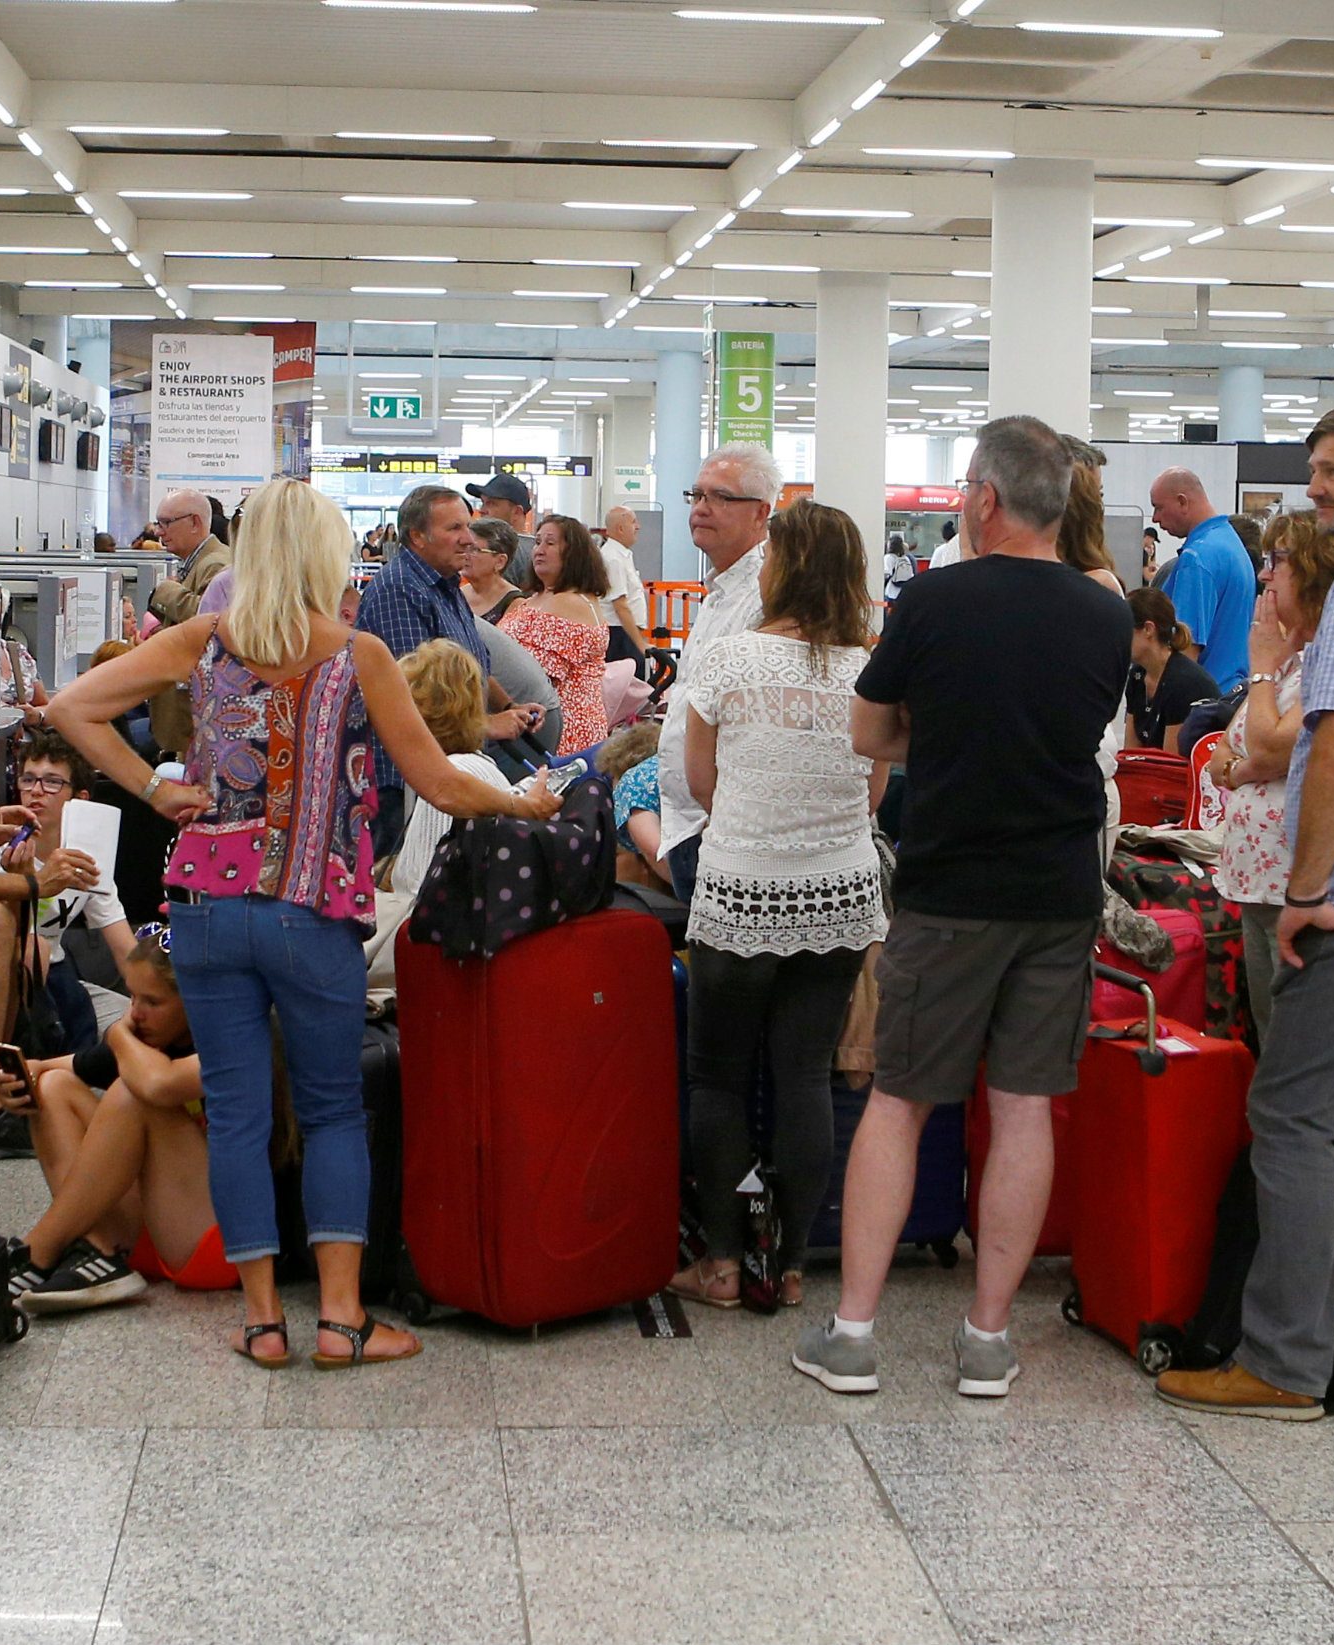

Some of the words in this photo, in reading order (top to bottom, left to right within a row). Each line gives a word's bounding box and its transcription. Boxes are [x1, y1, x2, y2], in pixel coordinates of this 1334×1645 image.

[273, 346, 313, 369] CAMPER
[159, 361, 191, 371] ENJOY
[160, 374, 179, 384] THE
[182, 374, 227, 385] AIRPORT
[231, 376, 265, 386] SHOPS
[158, 387, 166, 396] &
[169, 388, 244, 398] RESTAURANTS
[737, 374, 763, 413] 5
[158, 402, 190, 411] Disfruta
[192, 403, 203, 411] las
[205, 403, 234, 412] tiendas
[235, 405, 241, 413] y
[158, 413, 208, 422] restaurantes
[209, 414, 222, 422] del
[223, 415, 266, 424] aeropuerto
[186, 427, 195, 435] de
[196, 428, 205, 436] les
[187, 452, 224, 460] Commercial
[918, 496, 949, 504] IBERIA
